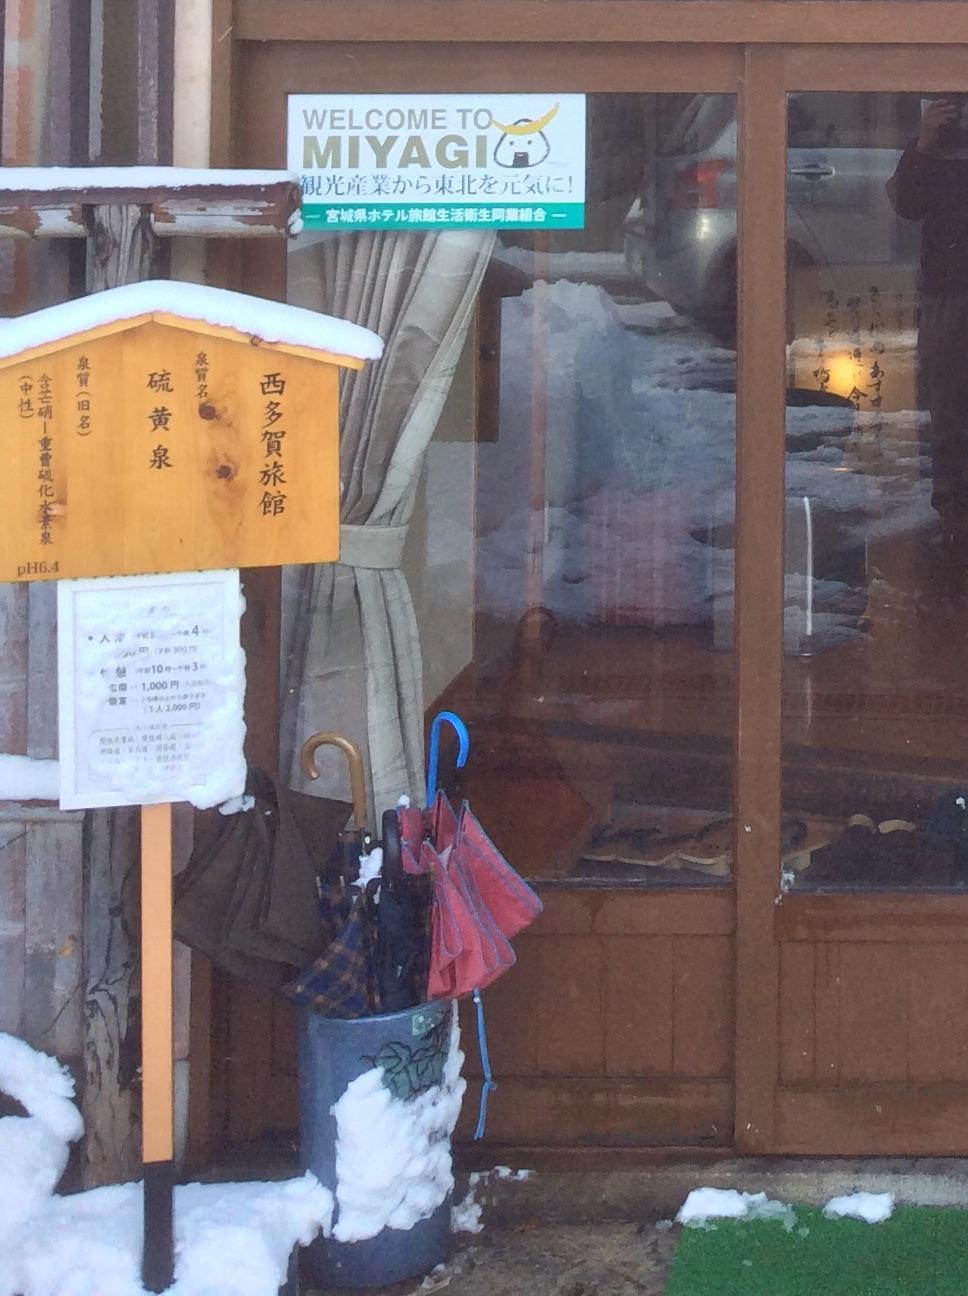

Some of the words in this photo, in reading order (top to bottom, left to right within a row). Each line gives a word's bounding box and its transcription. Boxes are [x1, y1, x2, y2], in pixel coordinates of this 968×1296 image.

[302, 108, 446, 130] WELCOME
[456, 108, 493, 130] TO
[302, 134, 488, 169] MIYAGI
[147, 370, 174, 470] 硫黄泉
[258, 372, 287, 518] 西多賀旅館
[17, 560, 60, 577] pH6.4
